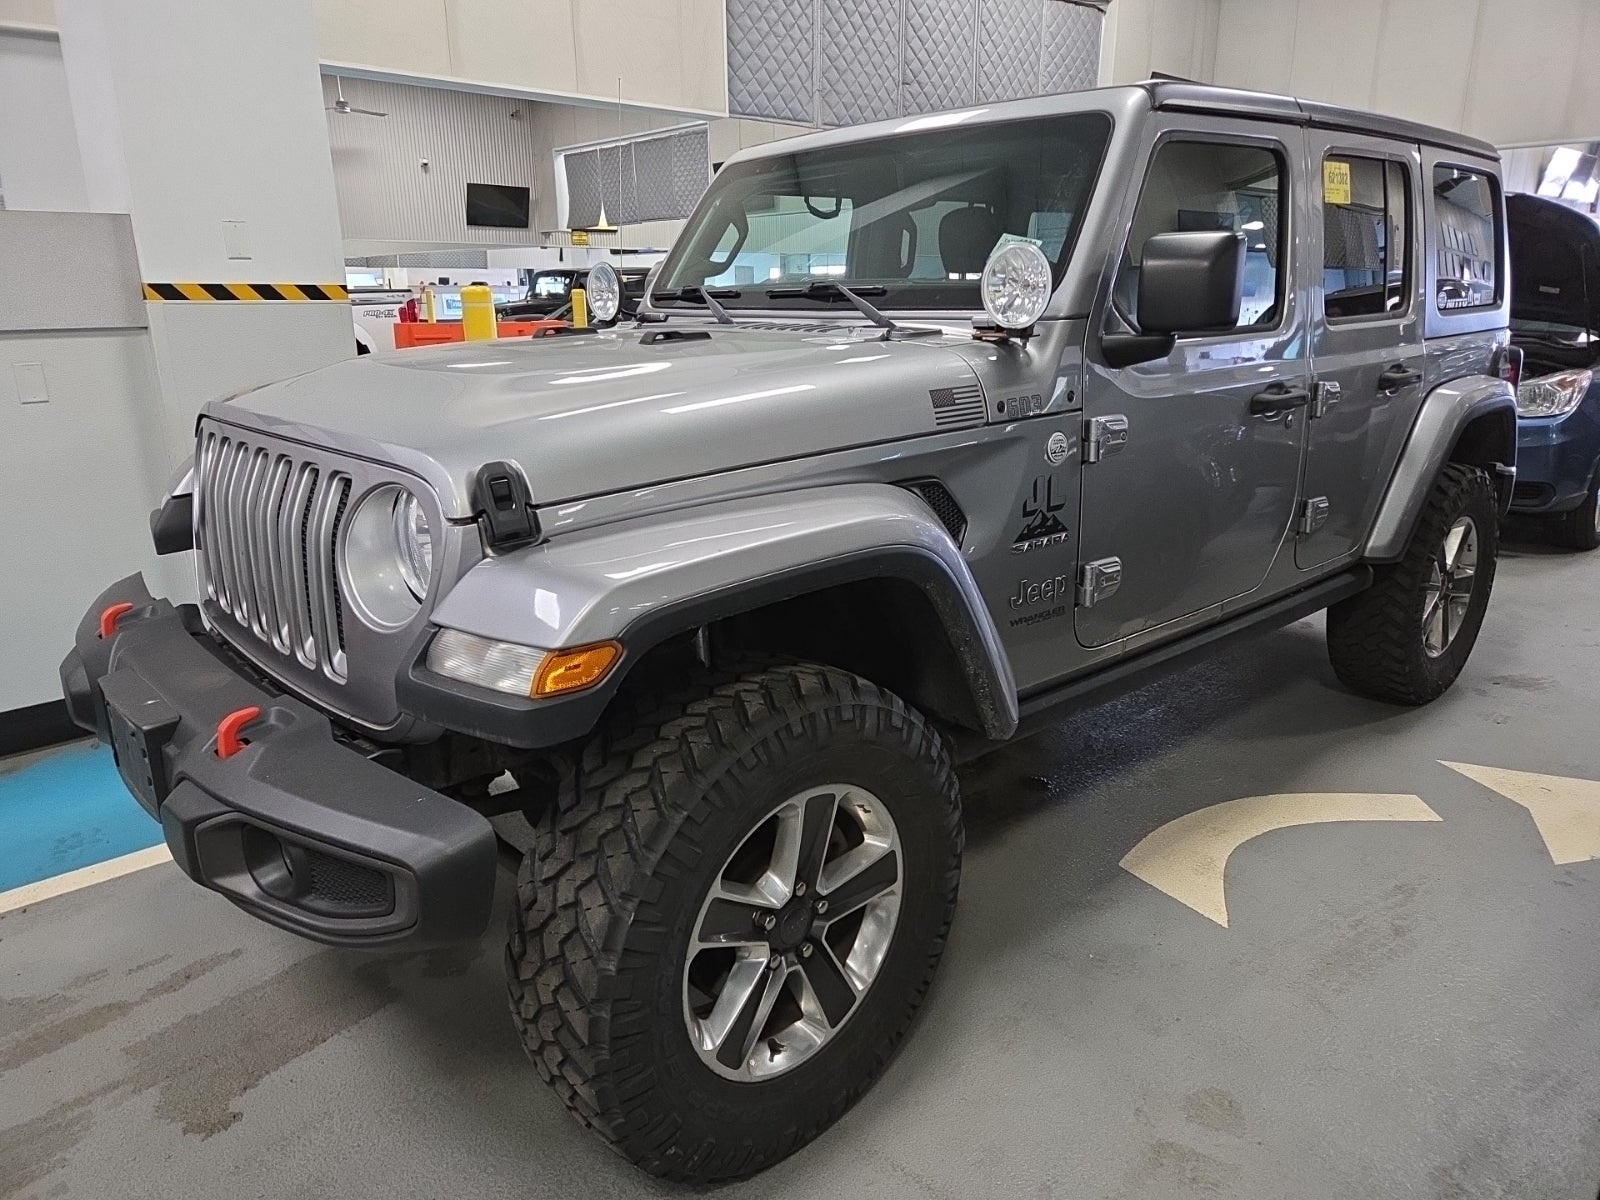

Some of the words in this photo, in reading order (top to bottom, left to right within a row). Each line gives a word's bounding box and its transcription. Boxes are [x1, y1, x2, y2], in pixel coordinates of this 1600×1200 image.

[1006, 394, 1042, 418] 503
[1022, 473, 1067, 518] JL
[1010, 532, 1069, 555] SAHARA
[1009, 574, 1067, 610] Jeep
